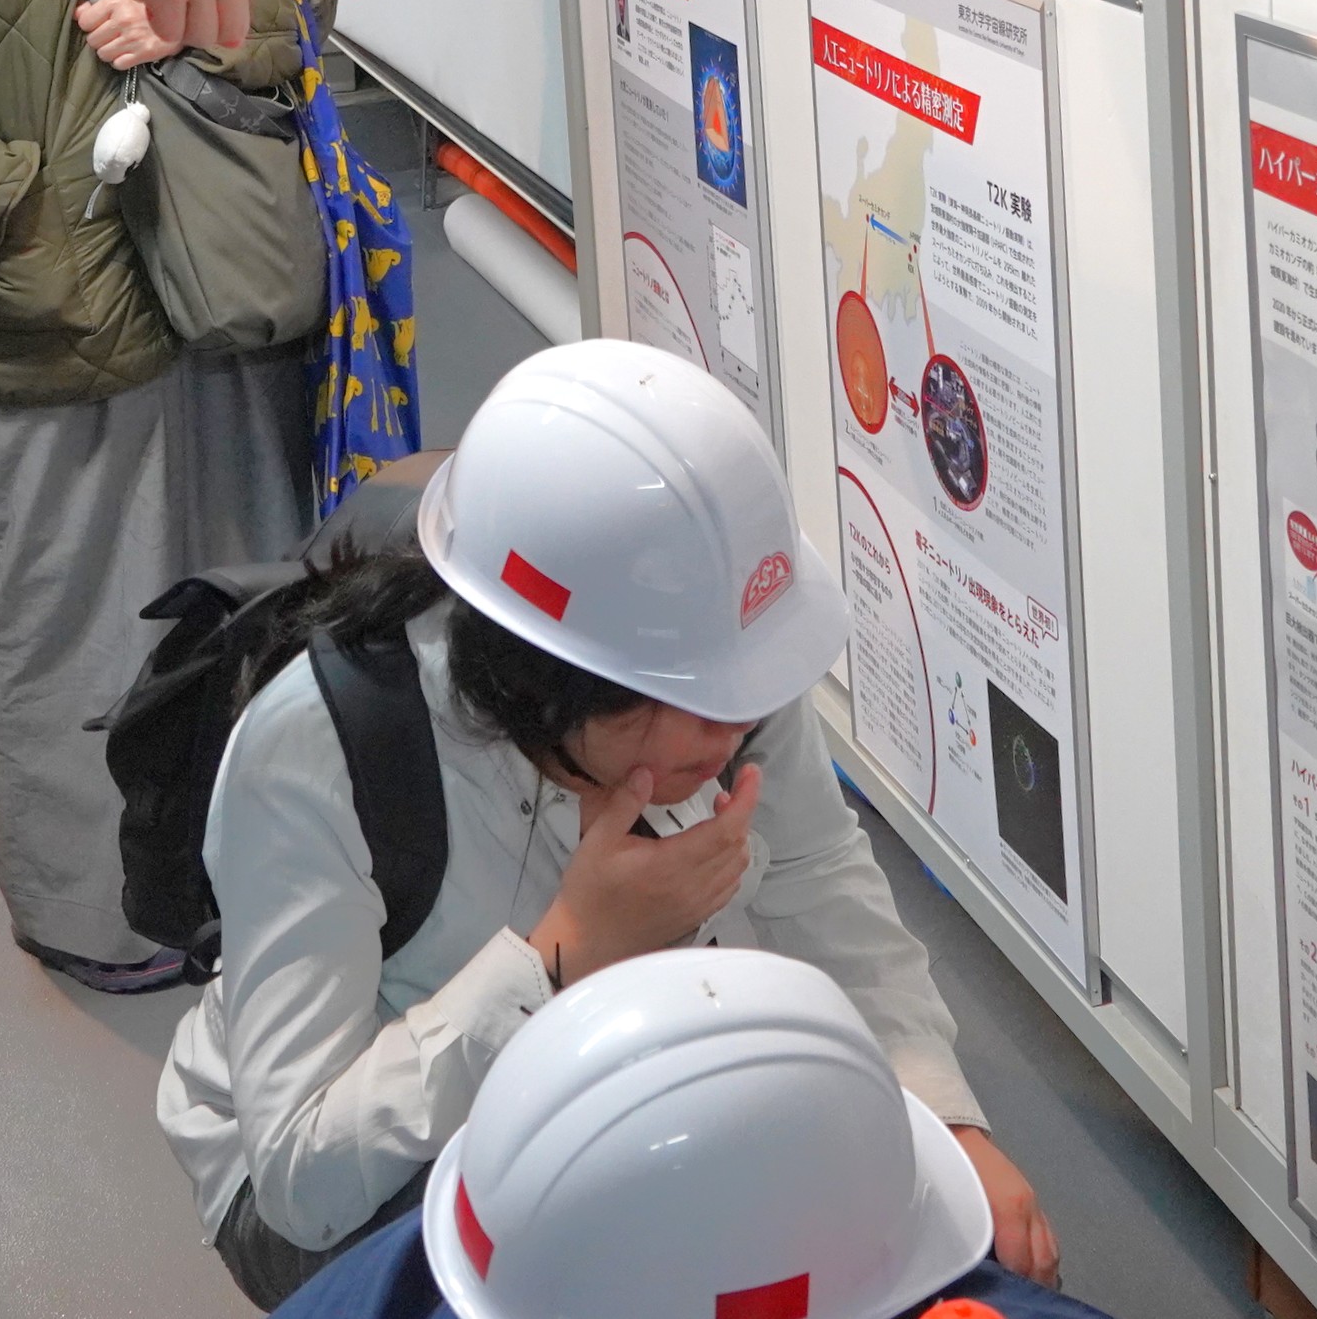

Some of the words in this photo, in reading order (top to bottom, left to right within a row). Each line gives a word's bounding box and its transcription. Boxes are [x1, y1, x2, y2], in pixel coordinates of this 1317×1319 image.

[958, 4, 1028, 46] 東京大学宇宙線研究所
[823, 34, 964, 133] 人工ニュートリノによる精密測定
[987, 181, 1008, 210] T2K
